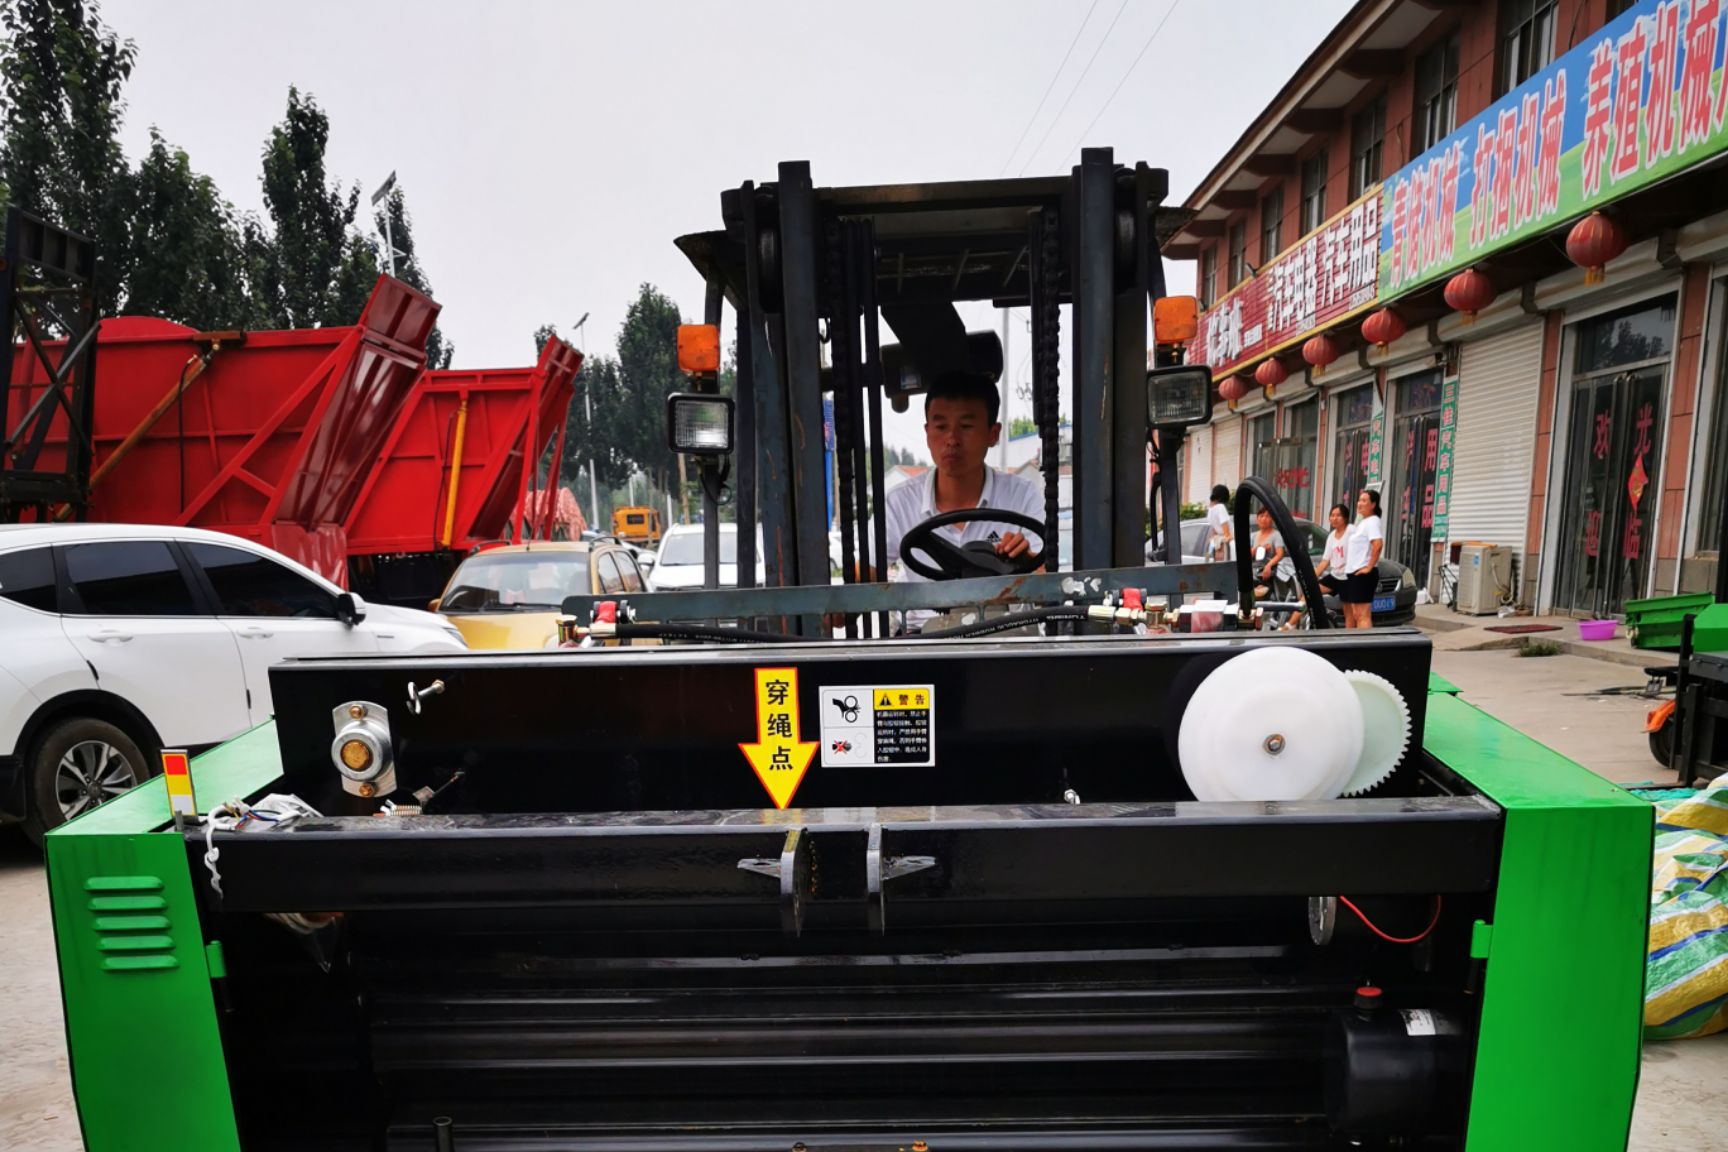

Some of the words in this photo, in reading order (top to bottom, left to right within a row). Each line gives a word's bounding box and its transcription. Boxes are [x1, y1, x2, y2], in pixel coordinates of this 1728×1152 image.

[1469, 69, 1567, 250] 打捆机械
[1581, 0, 1728, 201] 养殖机械
[1322, 196, 1378, 307] 汽车用品
[765, 679, 793, 771] 穿绳点
